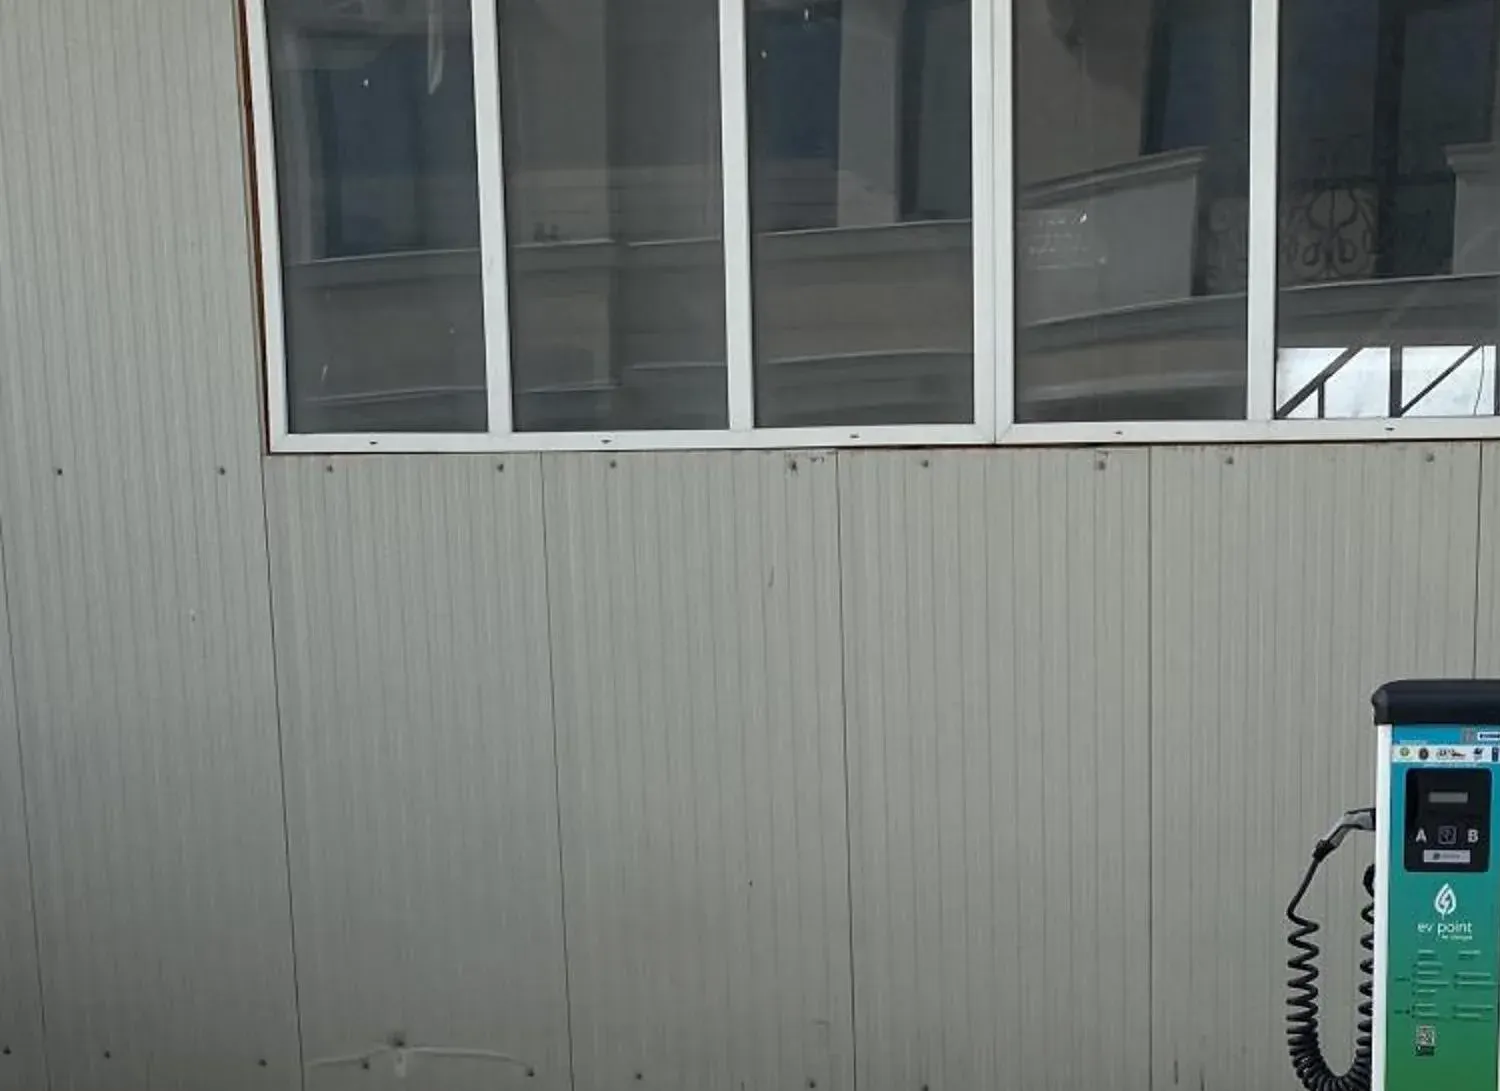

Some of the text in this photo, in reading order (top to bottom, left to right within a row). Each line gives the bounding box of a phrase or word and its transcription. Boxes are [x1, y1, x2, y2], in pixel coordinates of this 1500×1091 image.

[1416, 828, 1427, 843] A
[1467, 829, 1478, 843] B
[1417, 921, 1472, 937] ev point
